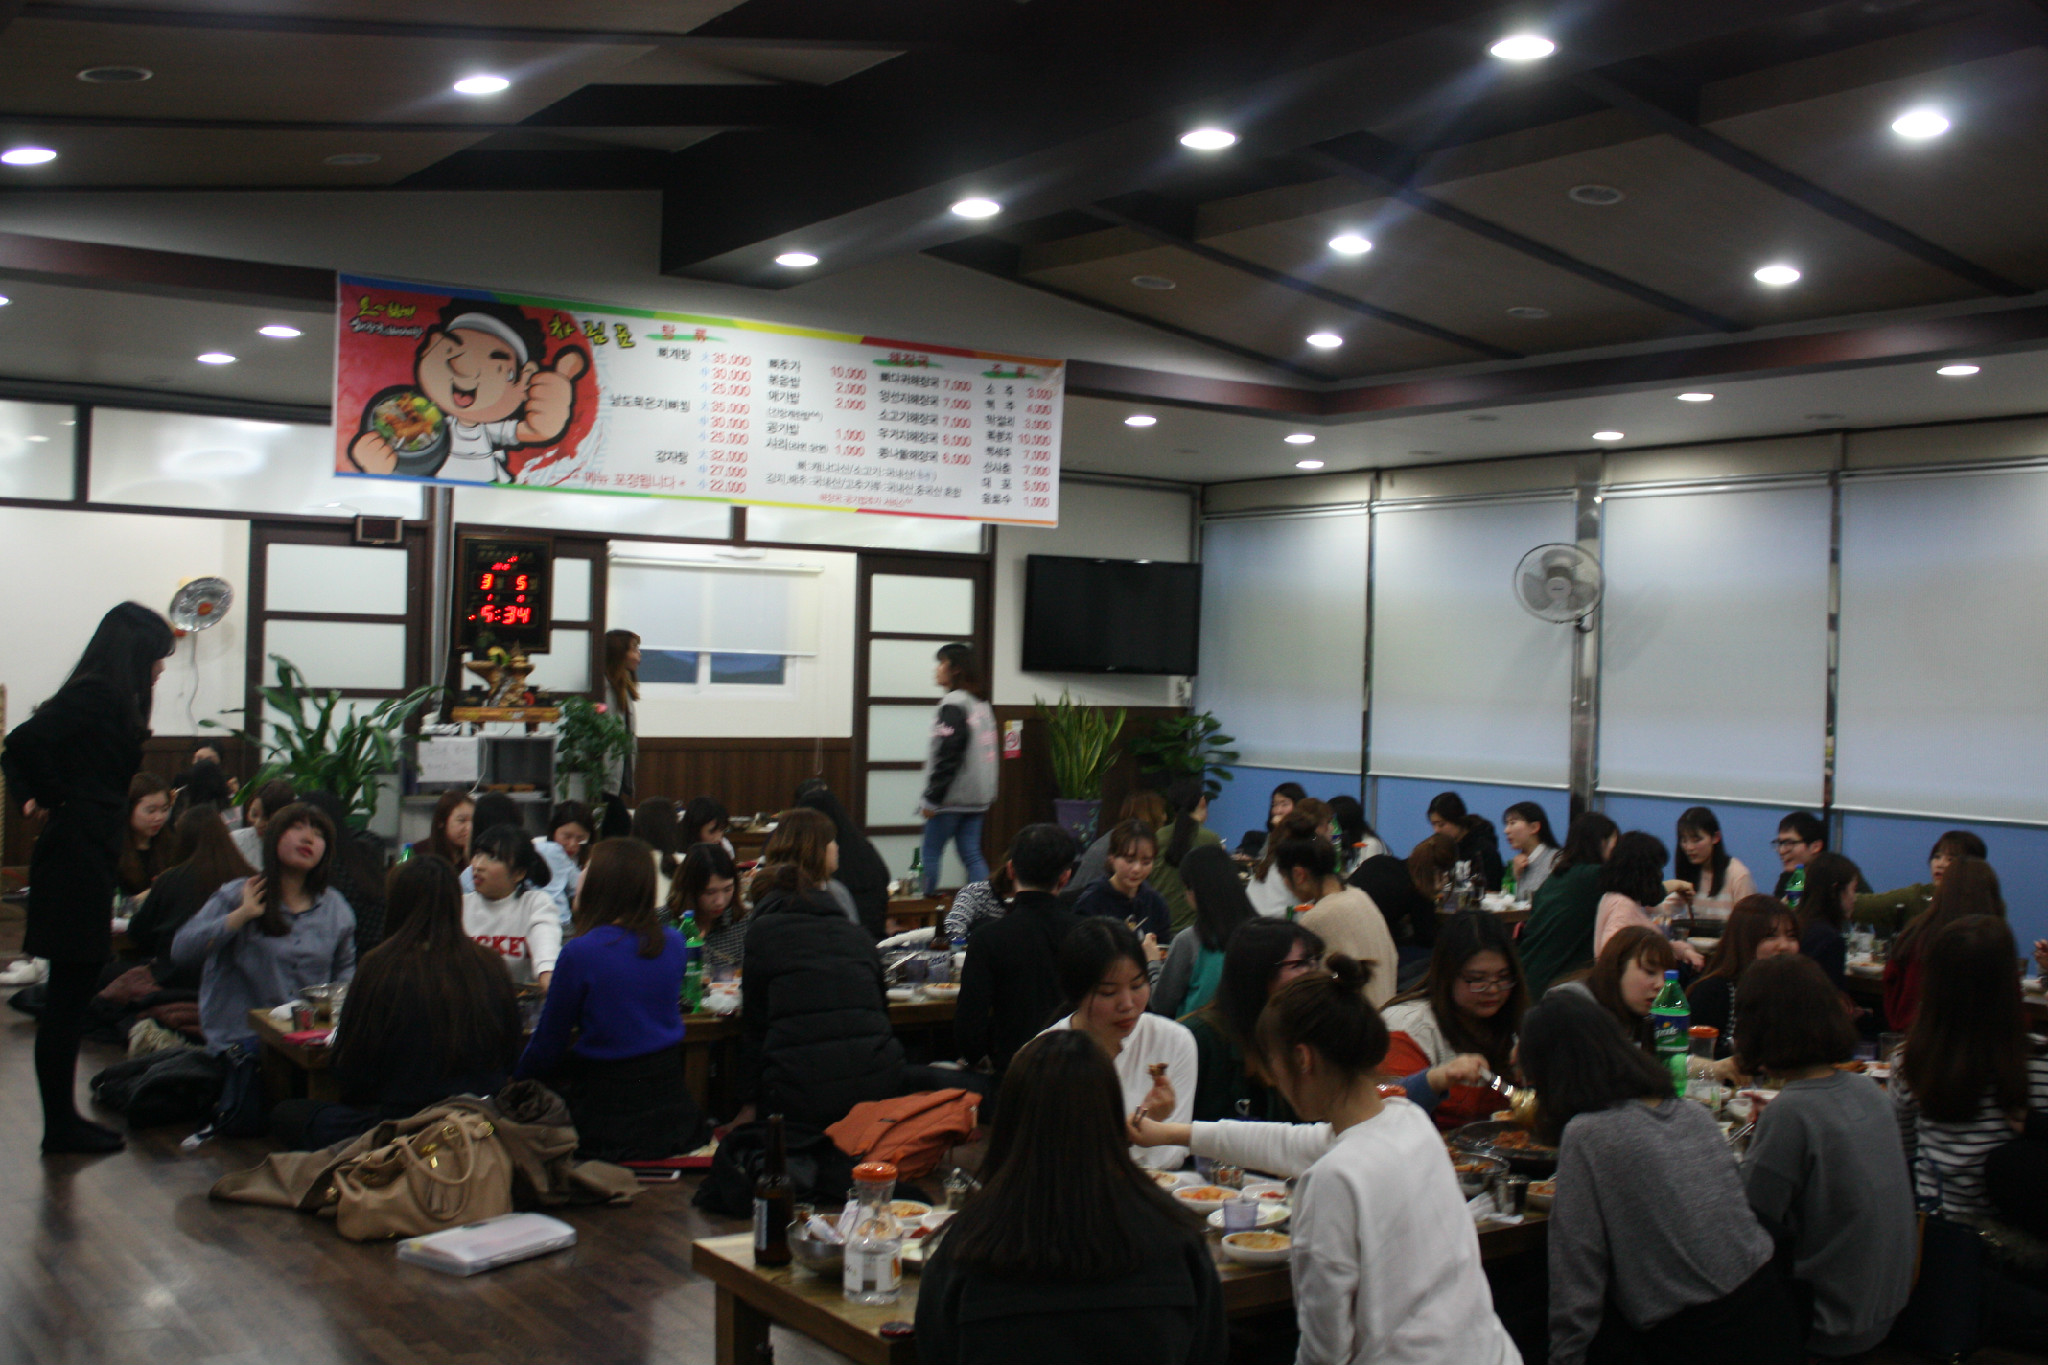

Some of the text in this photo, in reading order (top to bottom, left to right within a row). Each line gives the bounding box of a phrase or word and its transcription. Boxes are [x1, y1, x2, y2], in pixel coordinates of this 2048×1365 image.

[888, 351, 930, 370] 해장국
[480, 572, 495, 591] 3
[515, 574, 529, 592] 5
